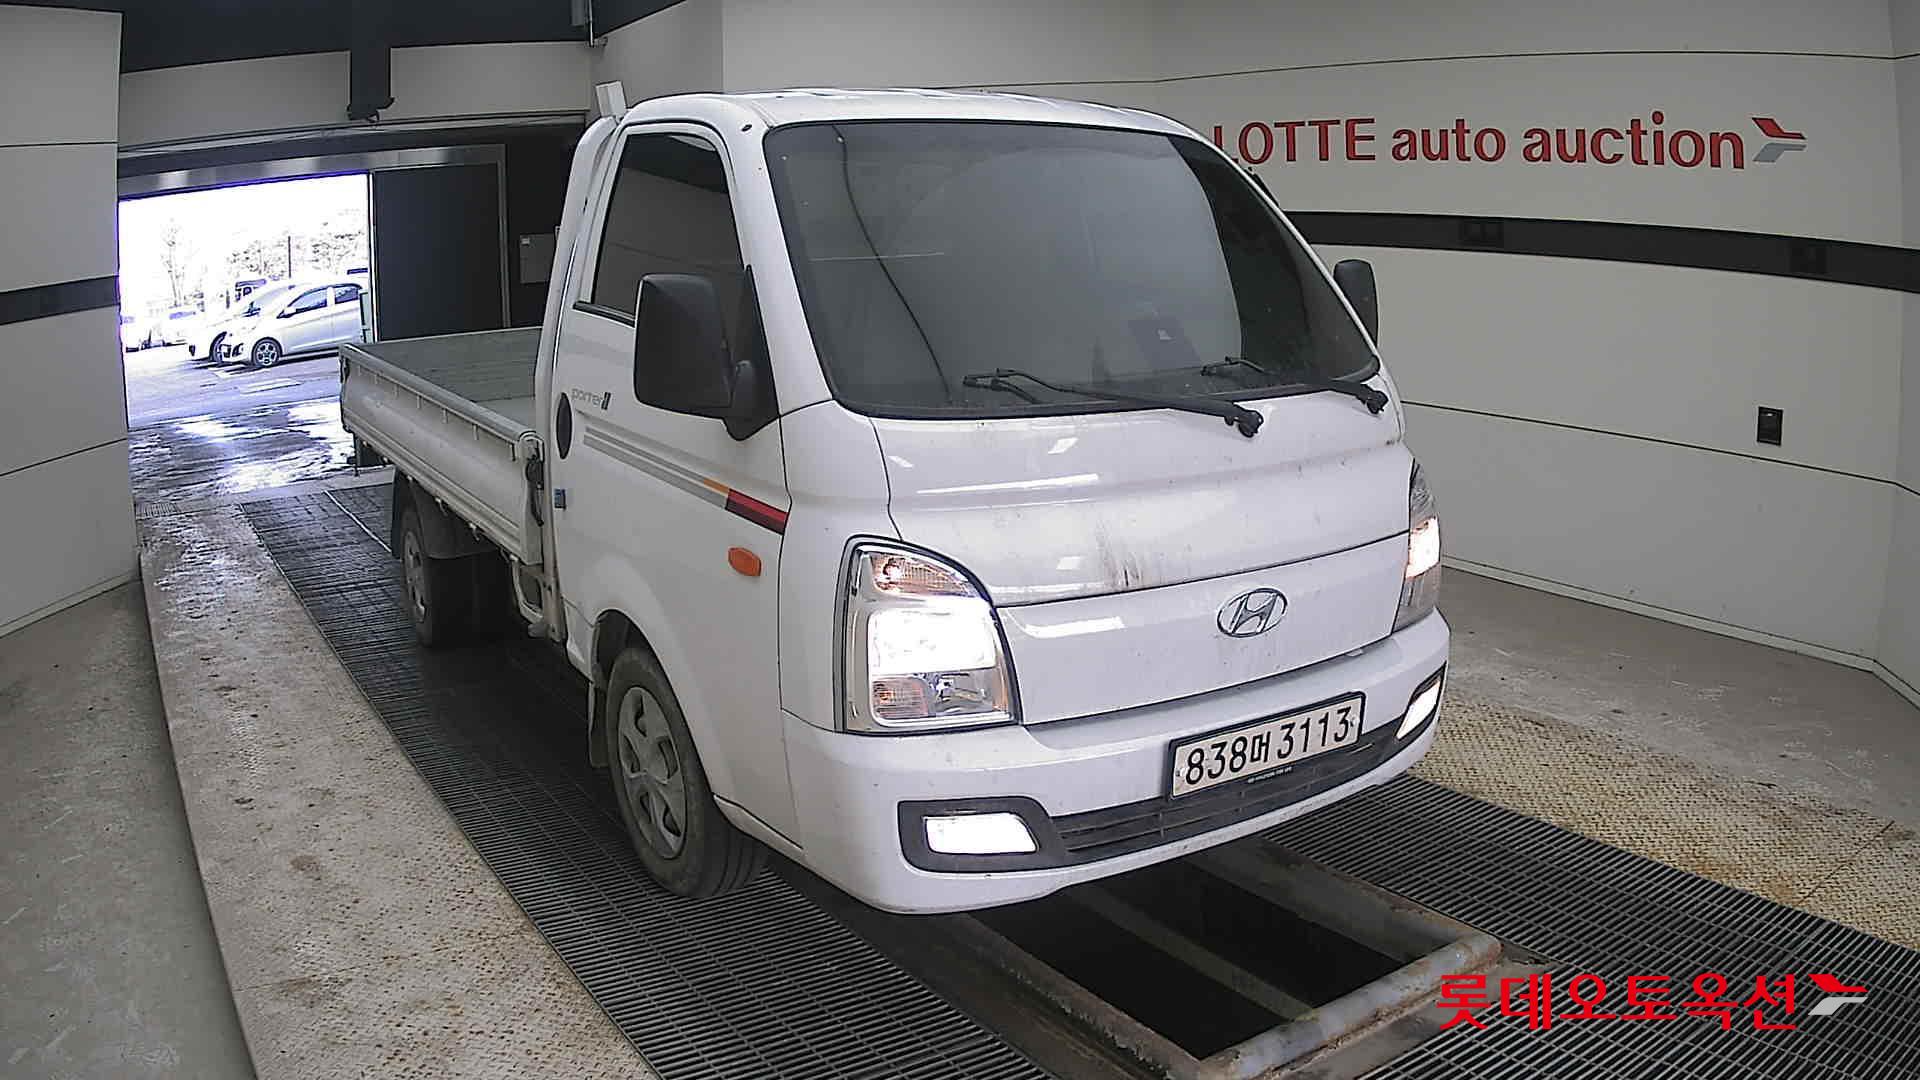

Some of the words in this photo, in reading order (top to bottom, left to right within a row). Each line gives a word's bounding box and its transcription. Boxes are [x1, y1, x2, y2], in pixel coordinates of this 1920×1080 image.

[1391, 117, 1506, 164] auto
[1522, 110, 1745, 170] auction
[1185, 730, 1271, 785] 838머
[1277, 706, 1352, 759] 3113
